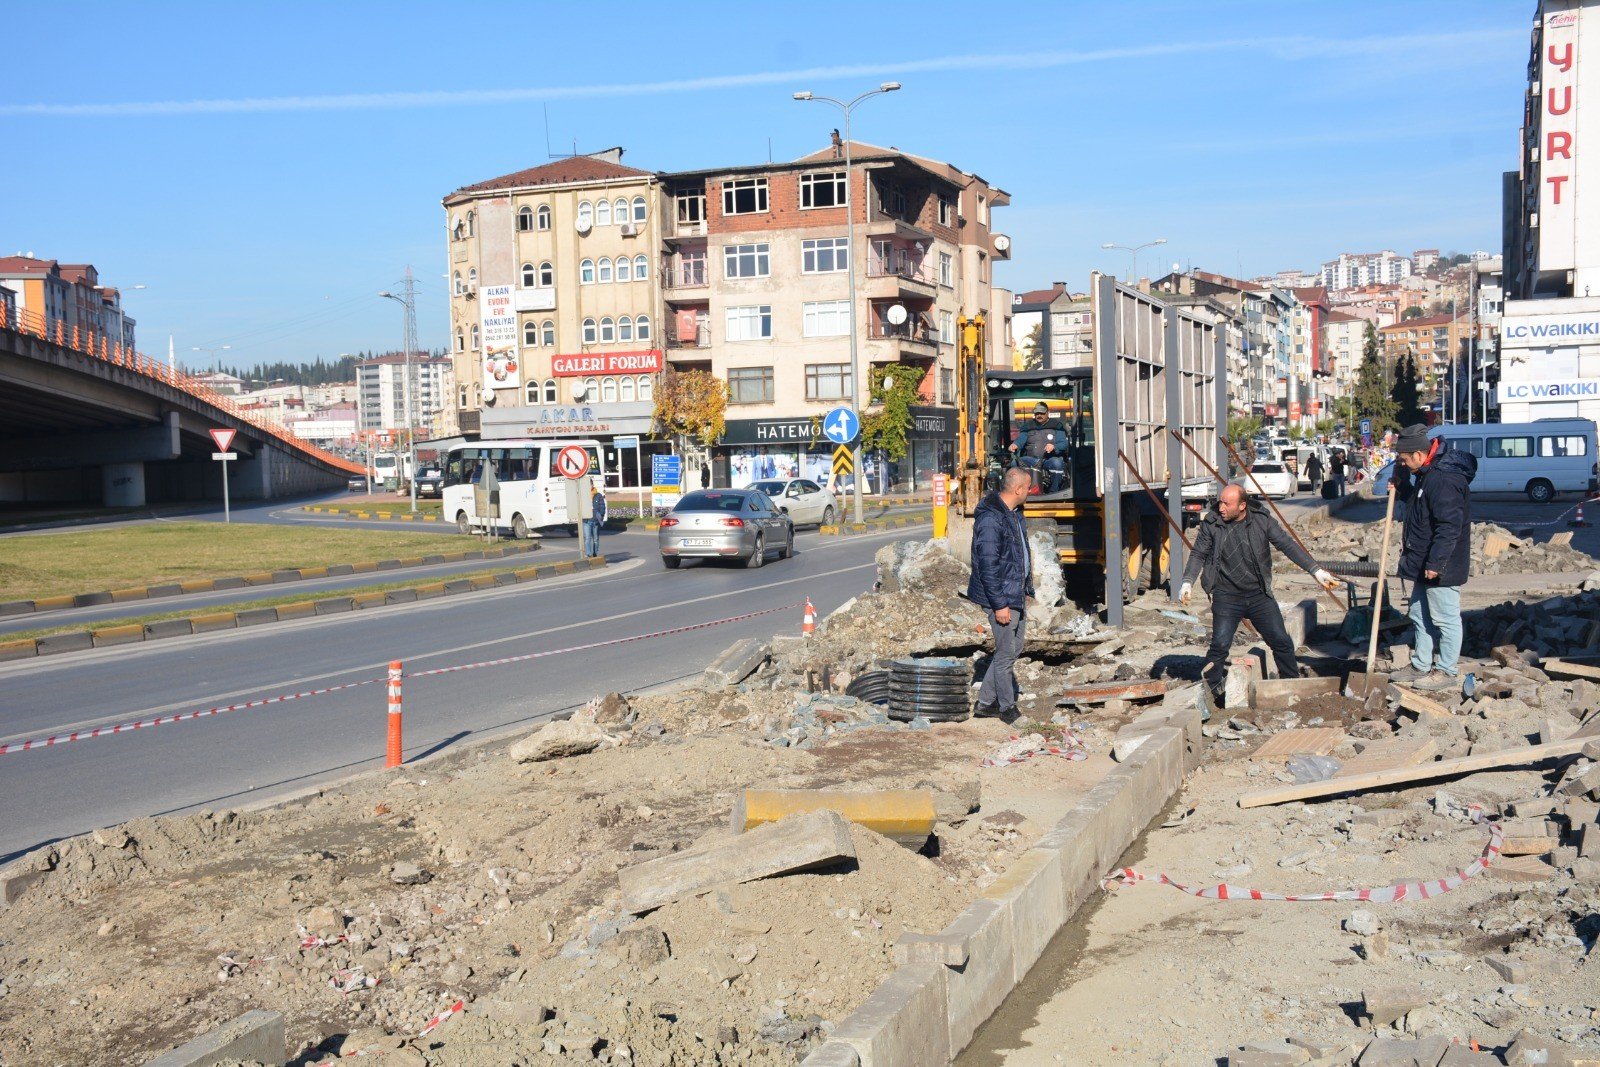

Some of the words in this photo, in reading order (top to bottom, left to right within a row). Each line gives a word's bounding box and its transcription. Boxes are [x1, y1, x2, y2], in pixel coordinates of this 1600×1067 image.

[1547, 42, 1573, 205] YURT
[487, 287, 510, 296] ALKAN
[487, 297, 510, 306] EVDEN
[493, 308, 506, 316] EVE
[1506, 326, 1528, 338] LC
[553, 354, 606, 372] GALERİ
[608, 355, 658, 370] FORUM
[1507, 385, 1529, 398] LC
[540, 407, 594, 423] AKAR
[915, 417, 946, 432] HATEMOĞLU
